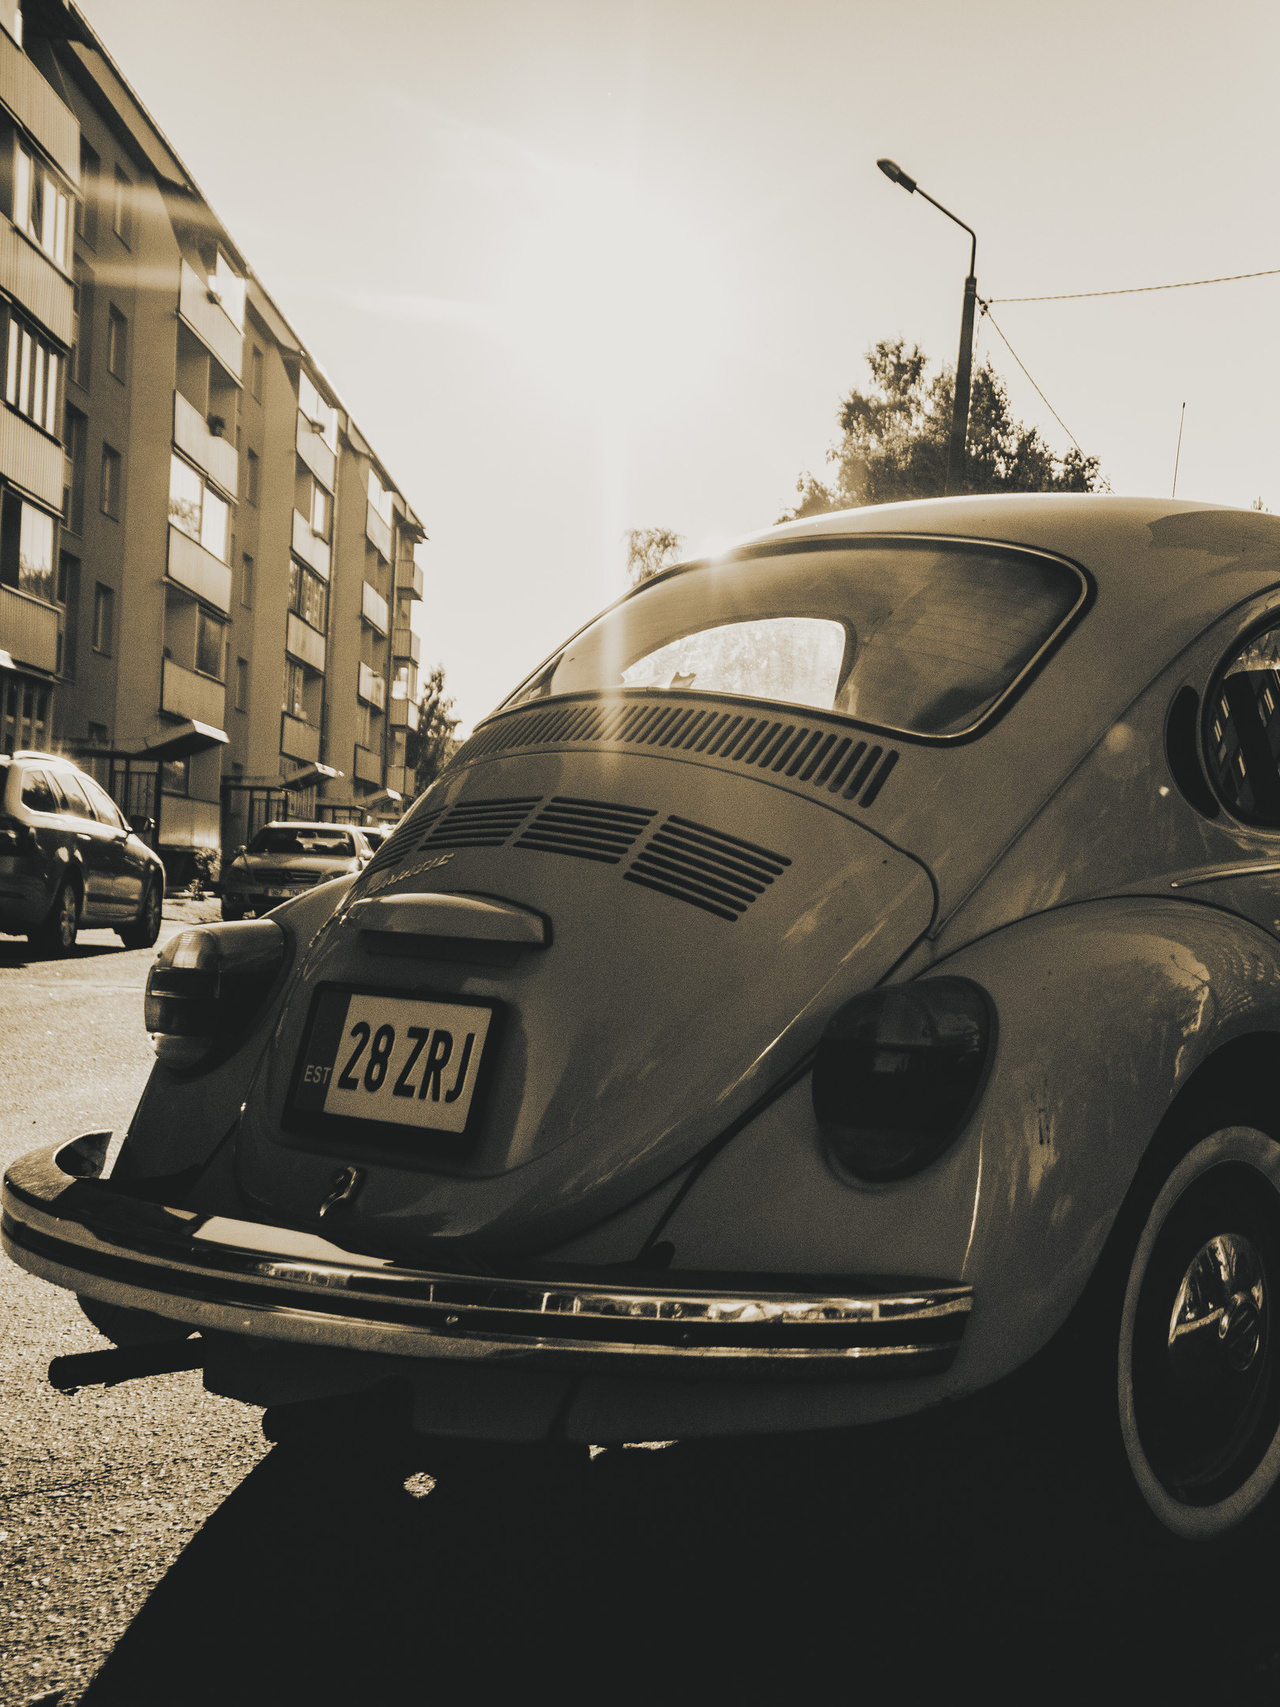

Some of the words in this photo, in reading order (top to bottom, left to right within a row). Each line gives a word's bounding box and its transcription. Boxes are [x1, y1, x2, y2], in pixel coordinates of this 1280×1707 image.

[304, 1064, 332, 1085] EST
[337, 1021, 395, 1093] 28
[393, 1026, 475, 1104] ZRJ
